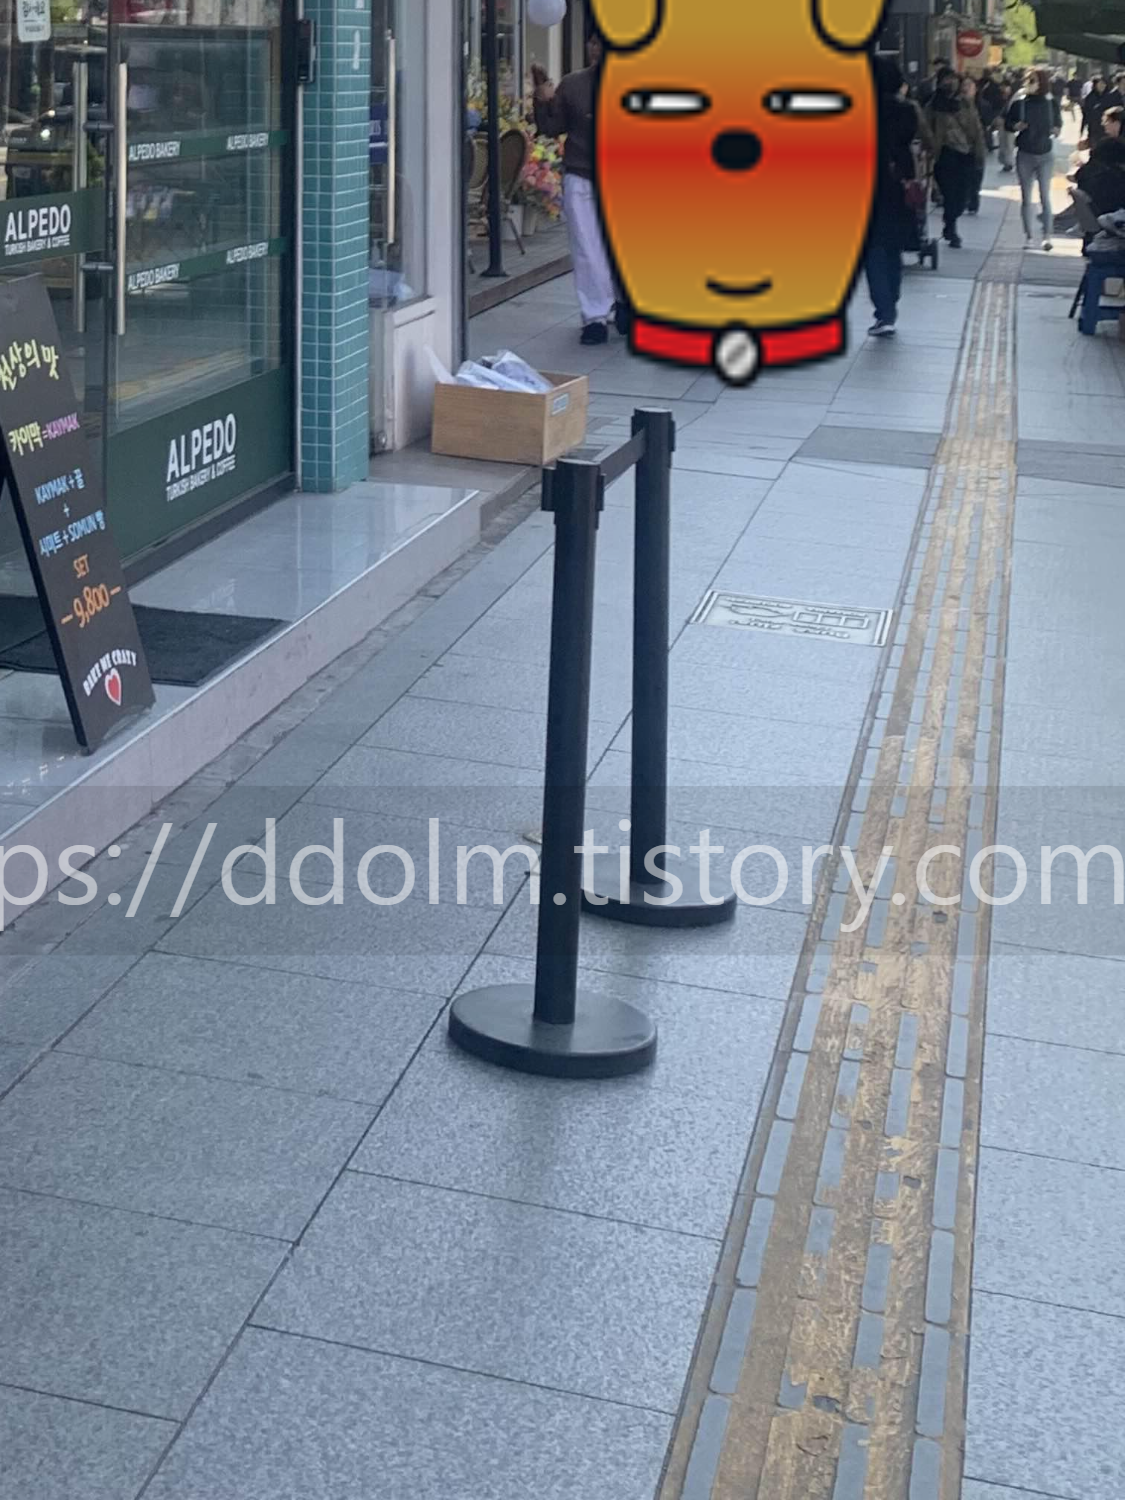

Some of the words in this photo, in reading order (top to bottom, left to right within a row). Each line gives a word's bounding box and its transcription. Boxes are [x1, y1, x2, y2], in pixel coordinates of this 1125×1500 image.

[128, 143, 156, 162] ALPEDO
[5, 204, 72, 243] ALPEDO
[127, 269, 155, 290] ALPEDO
[167, 413, 236, 483] ALPEDO
[73, 553, 90, 579] SET
